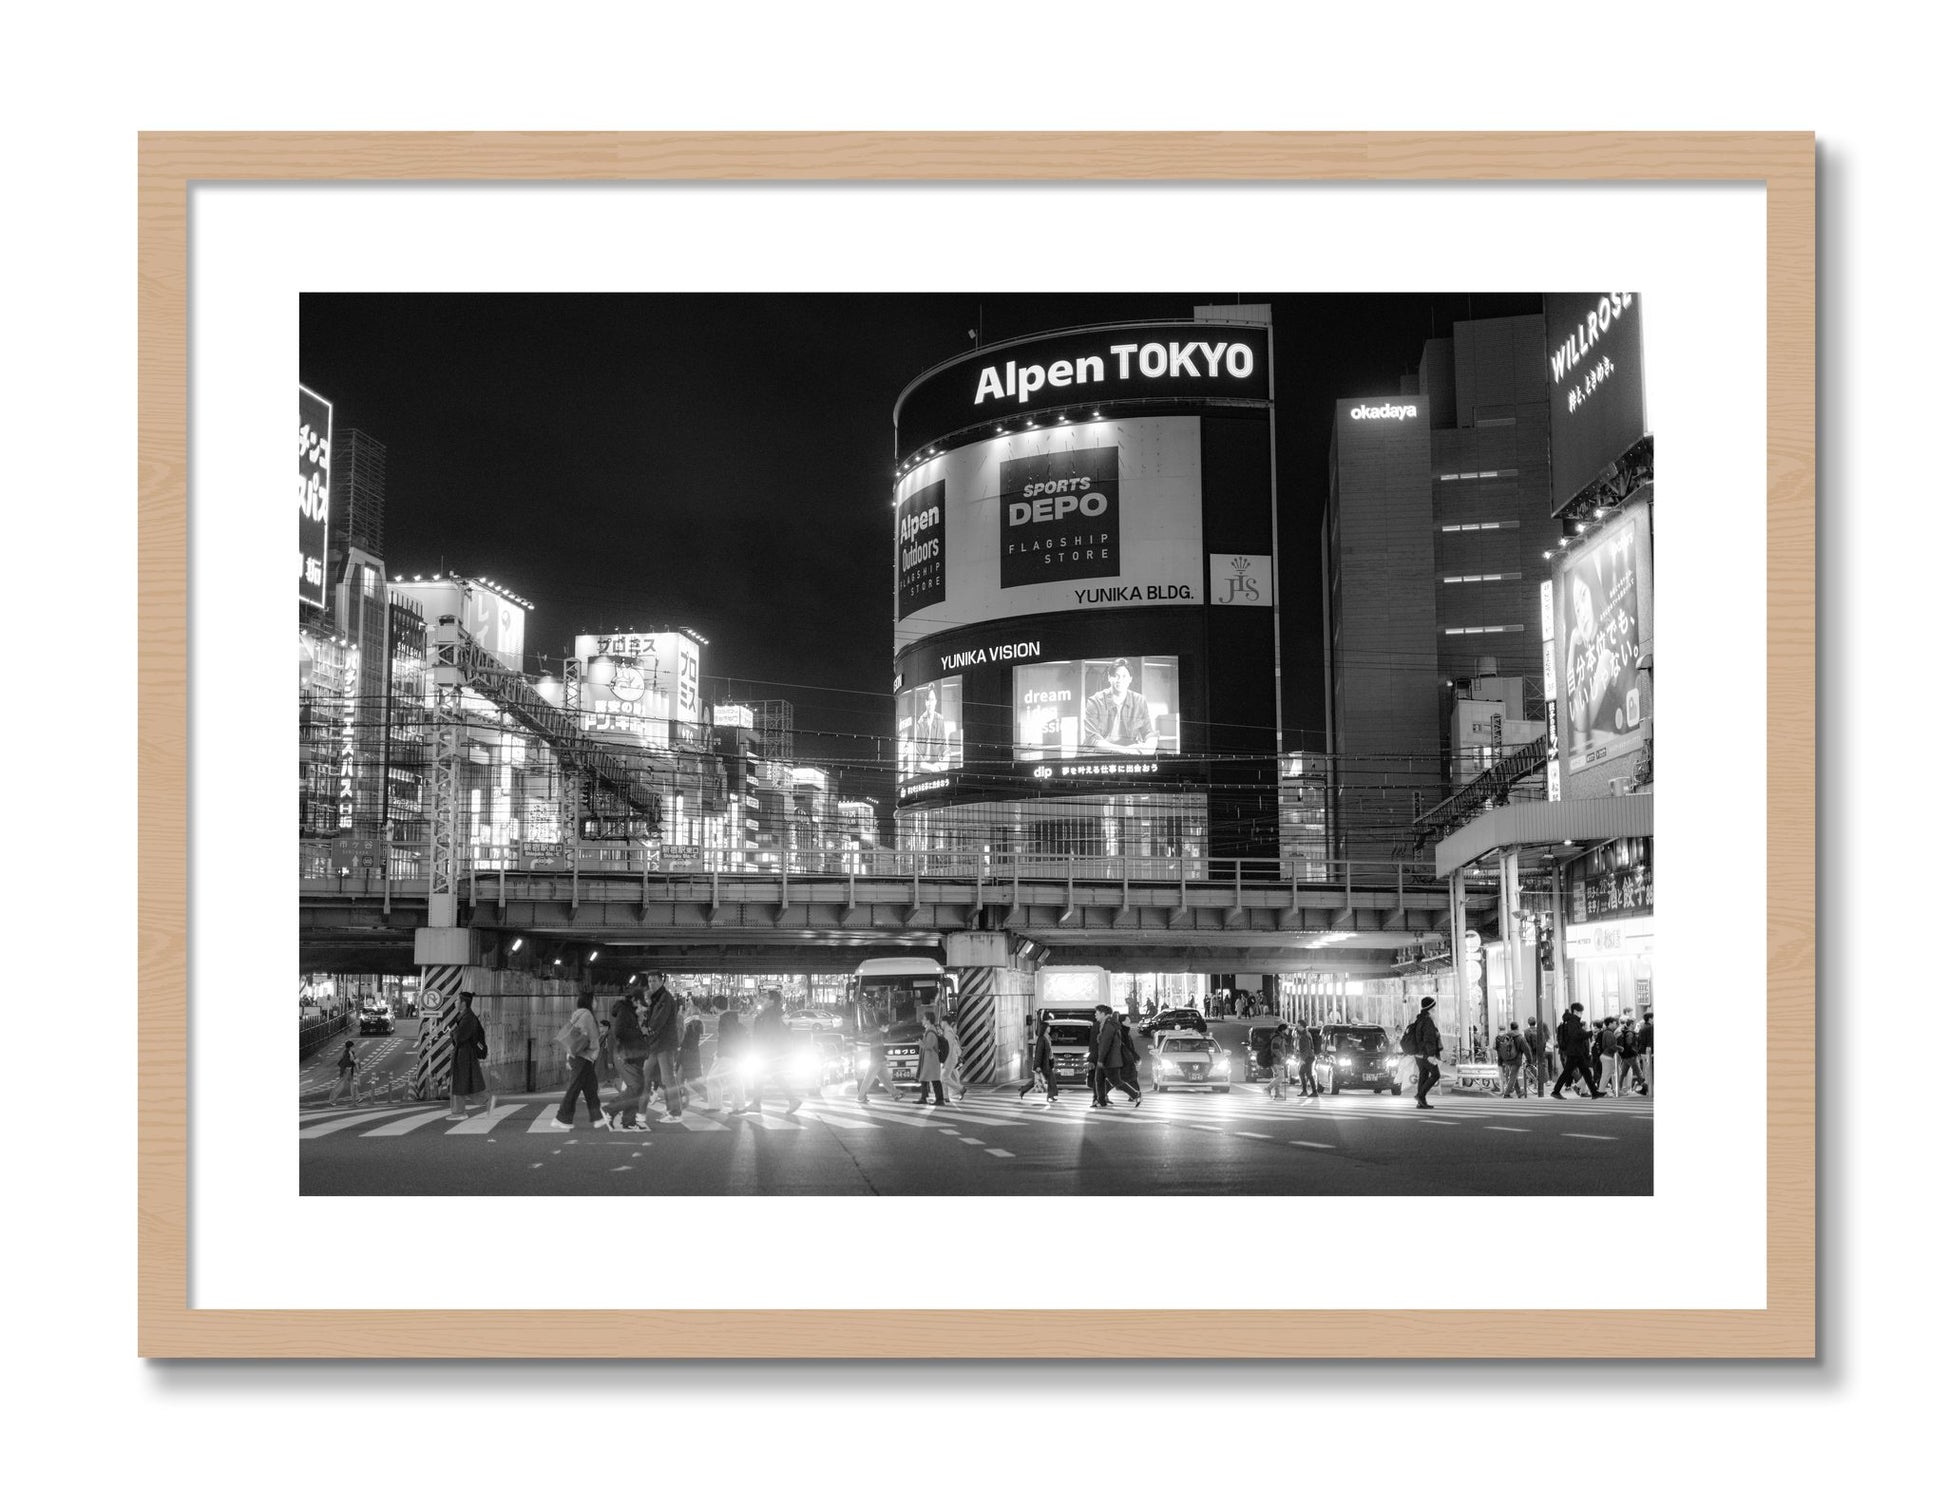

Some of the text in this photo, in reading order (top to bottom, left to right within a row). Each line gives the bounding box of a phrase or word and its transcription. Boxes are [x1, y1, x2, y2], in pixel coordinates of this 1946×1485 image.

[974, 341, 1254, 405] Alpen TOKYO
[1350, 402, 1417, 420] okadaya
[1023, 476, 1091, 498] SPORTS
[1009, 492, 1108, 527] DEPO
[900, 506, 939, 545] Alpen
[1009, 533, 1108, 554] FLAGSHIP
[902, 538, 939, 573] Outdoors
[1044, 549, 1109, 564] STORE
[1075, 585, 1194, 604] YUNIKA BLDG.
[597, 637, 656, 654] プロミス
[940, 641, 1041, 671] YUNIKA VISION
[1024, 689, 1072, 704] dream
[1034, 766, 1053, 779] dip
